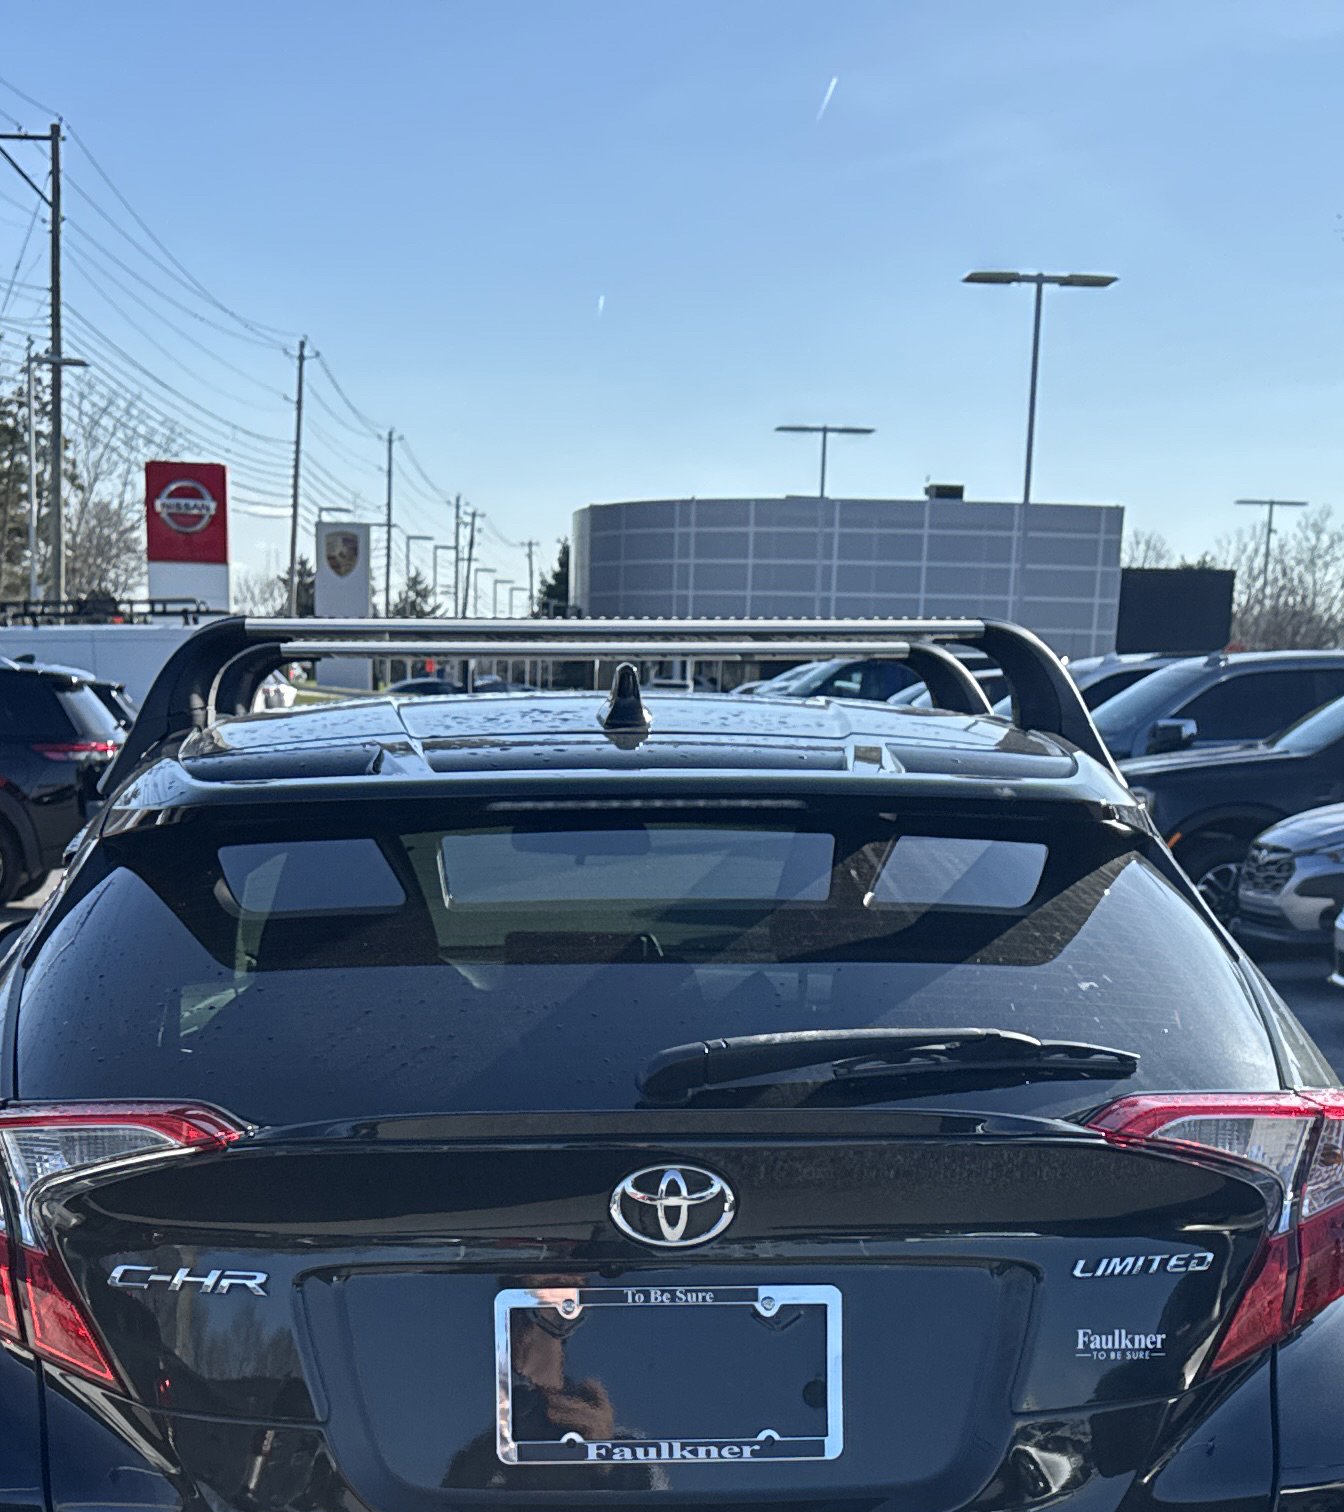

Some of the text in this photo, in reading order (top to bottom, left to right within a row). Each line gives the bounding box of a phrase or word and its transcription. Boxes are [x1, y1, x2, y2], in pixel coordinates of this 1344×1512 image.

[160, 502, 211, 512] NISSAN
[1072, 1252, 1215, 1278] LIMITED
[107, 1264, 269, 1297] C-HR
[623, 1288, 715, 1304] To Be Sure
[1076, 1329, 1167, 1350] Faulkner
[1092, 1351, 1150, 1360] TO BE SURE
[584, 1442, 761, 1460] Faulkner
